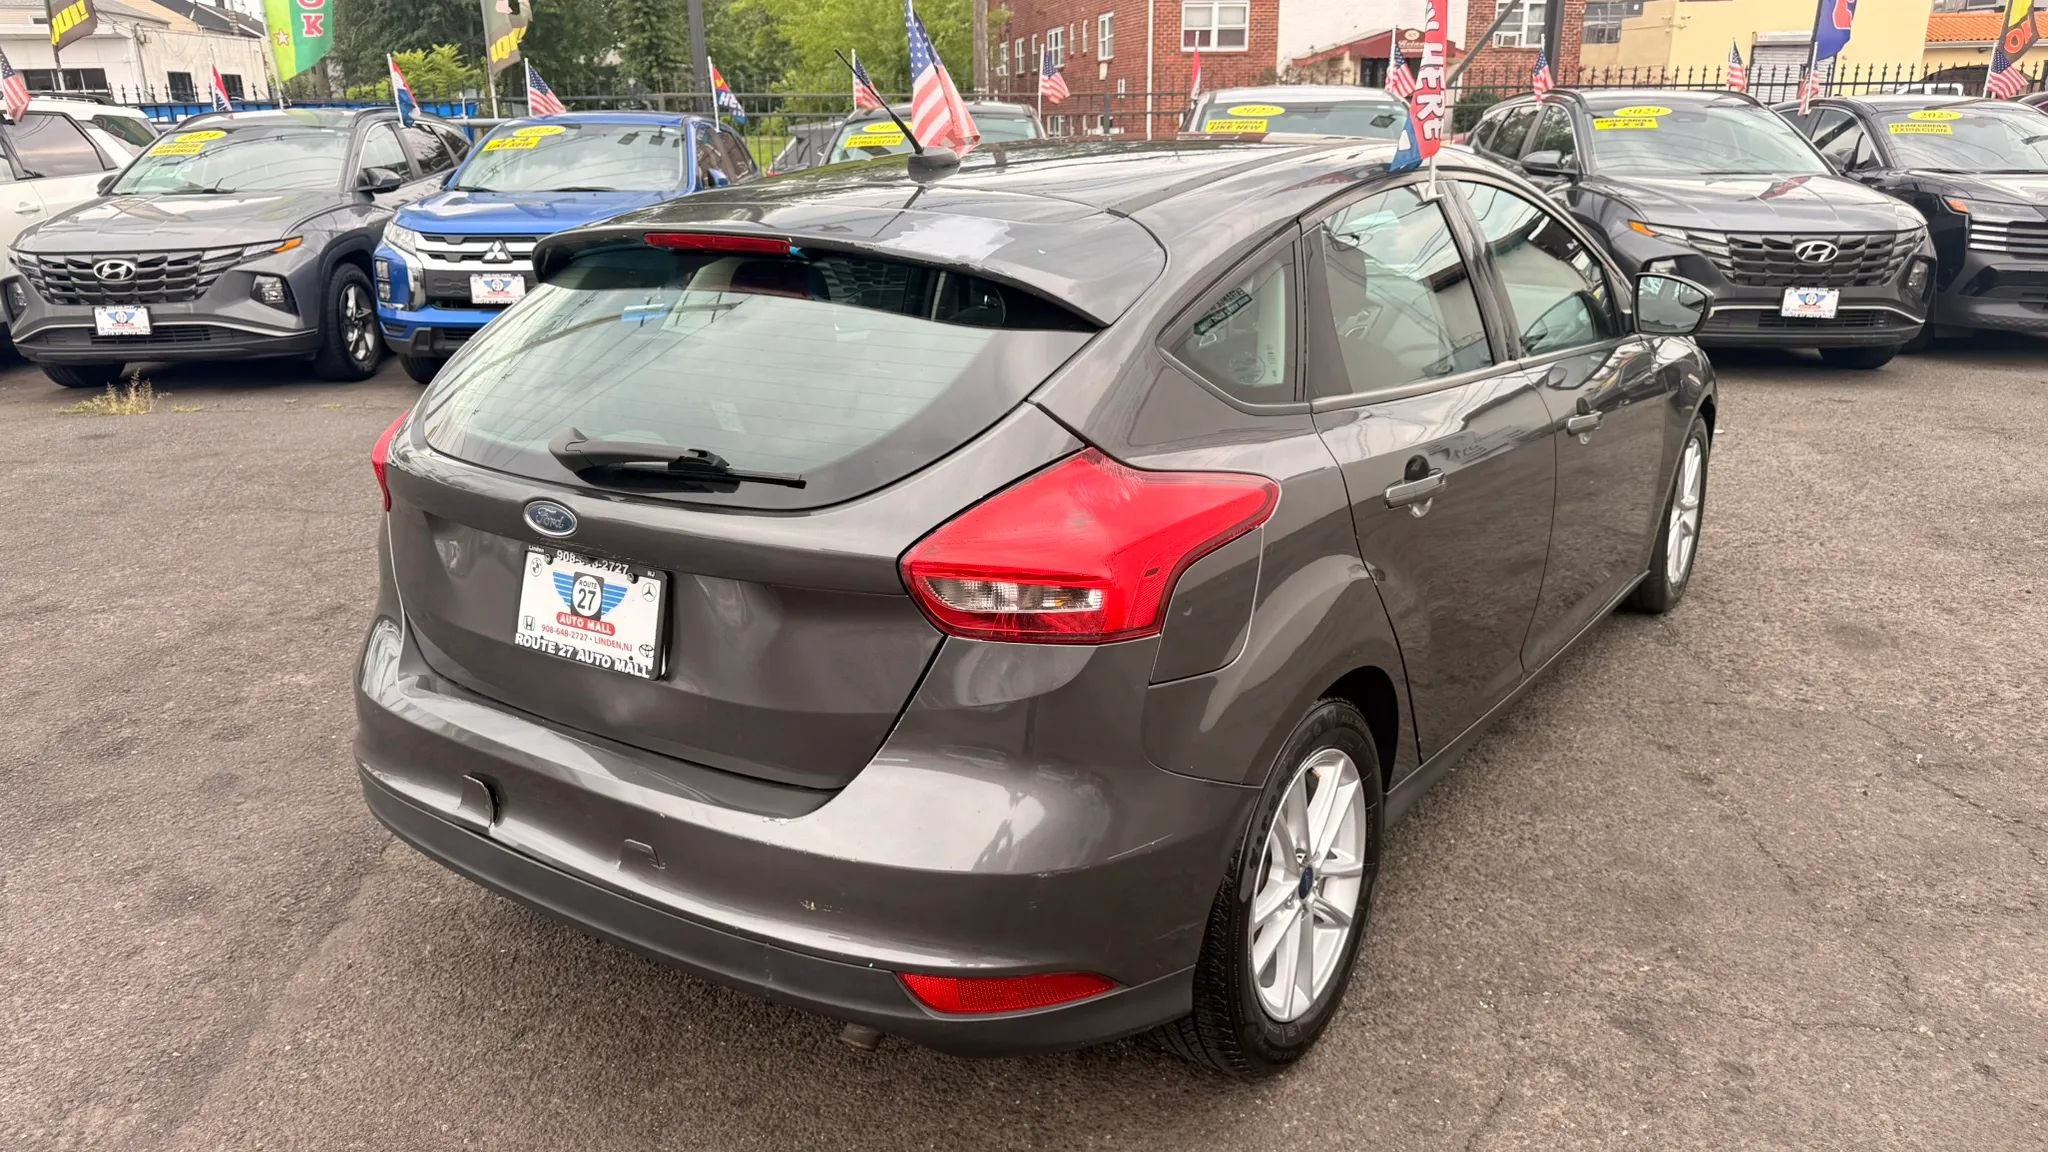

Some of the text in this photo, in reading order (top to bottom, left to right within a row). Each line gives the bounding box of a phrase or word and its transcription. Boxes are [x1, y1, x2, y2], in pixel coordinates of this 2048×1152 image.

[535, 507, 564, 529] Ford
[528, 544, 545, 553] Linden
[556, 550, 629, 575] 908--2727
[578, 580, 598, 589] ROUTE
[577, 588, 597, 611] 27
[541, 624, 588, 641] 908-648-2727
[560, 614, 612, 634] AUTO MALL
[515, 632, 650, 679] ROUTE 27 AUTO MALL
